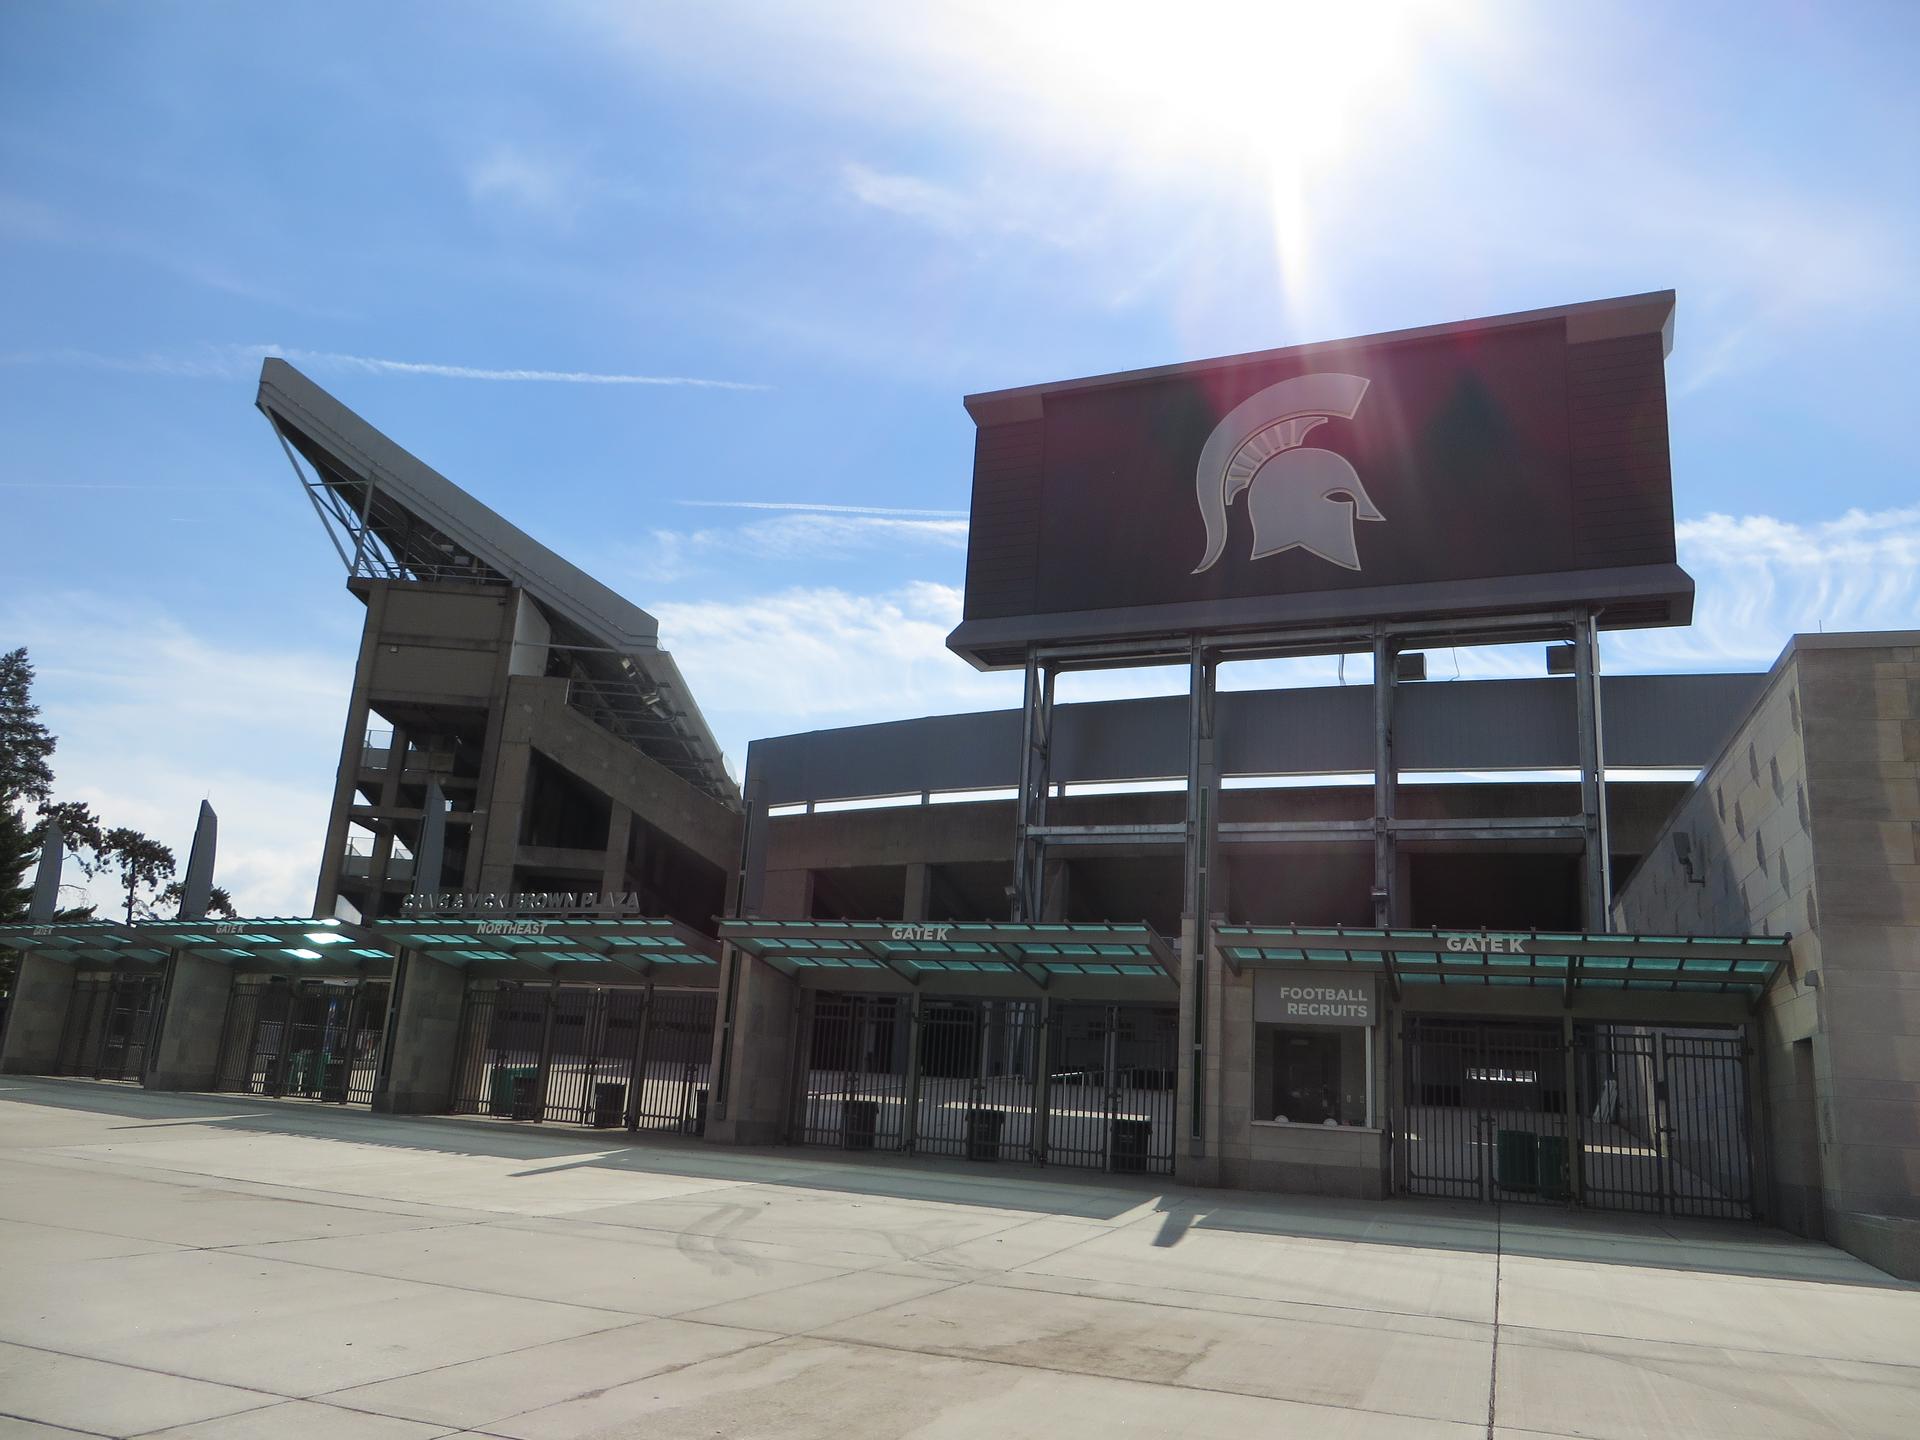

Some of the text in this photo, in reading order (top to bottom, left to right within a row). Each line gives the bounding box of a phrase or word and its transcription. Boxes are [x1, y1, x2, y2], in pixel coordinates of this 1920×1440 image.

[514, 892, 577, 909] BROWN
[580, 891, 640, 909] PLAZA
[476, 922, 548, 935] NORTHEAST
[892, 927, 948, 940] GATE K
[1446, 936, 1526, 953] GATE K
[1280, 987, 1368, 1002] FOOTBALL
[1287, 1002, 1368, 1018] RECRUITS
